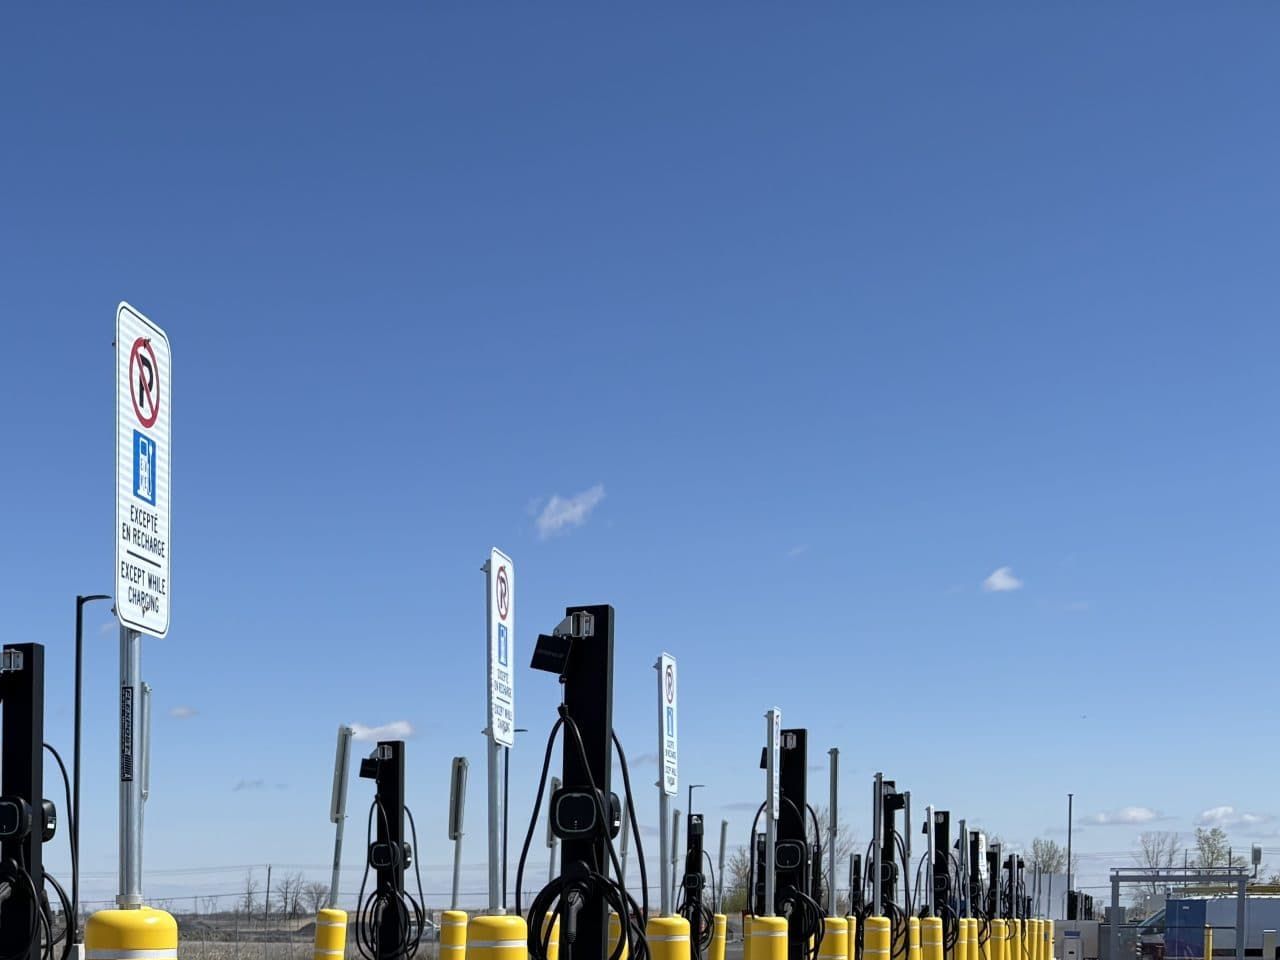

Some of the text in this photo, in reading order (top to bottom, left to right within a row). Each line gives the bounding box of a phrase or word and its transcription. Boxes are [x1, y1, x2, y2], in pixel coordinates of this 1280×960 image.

[130, 504, 158, 534] EXCEPTÉ
[122, 521, 165, 558] EN RECHARGE
[121, 560, 166, 596] EXCEPT WHILE
[128, 585, 160, 613] CHARGING
